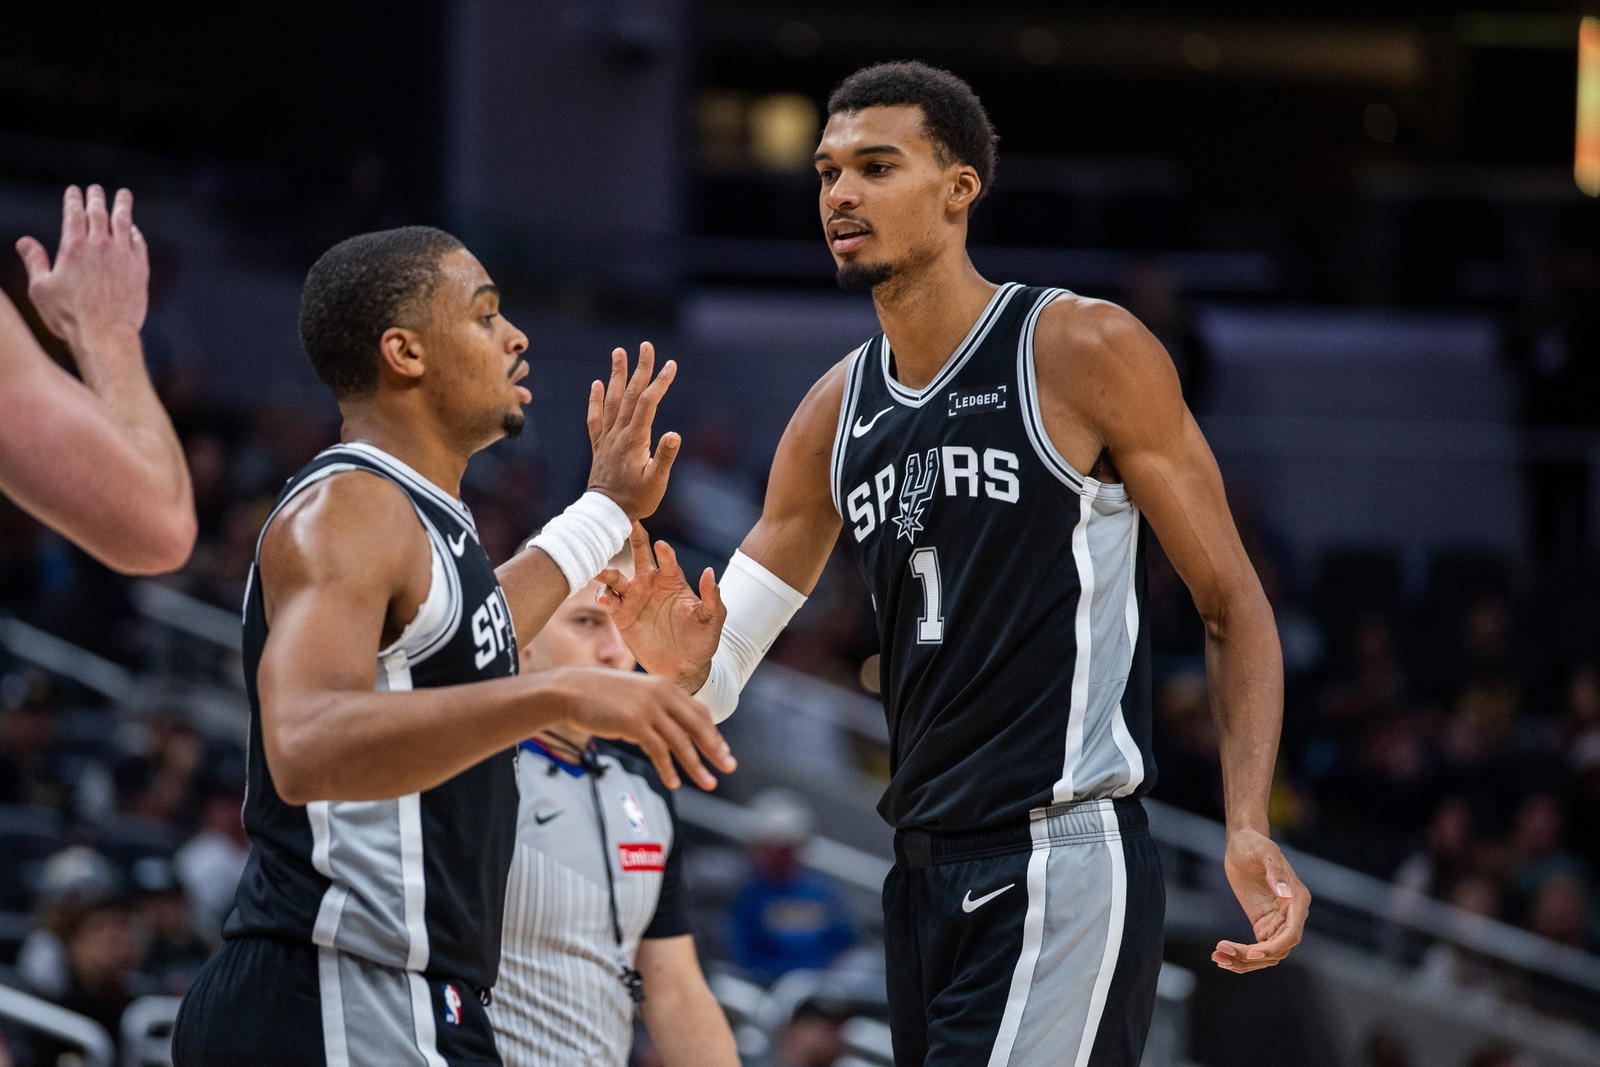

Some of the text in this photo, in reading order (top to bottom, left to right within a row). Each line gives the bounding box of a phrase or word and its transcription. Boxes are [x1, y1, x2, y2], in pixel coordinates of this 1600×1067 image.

[955, 393, 999, 409] LEDGER
[847, 446, 1020, 544] SPURS
[908, 546, 944, 644] 1
